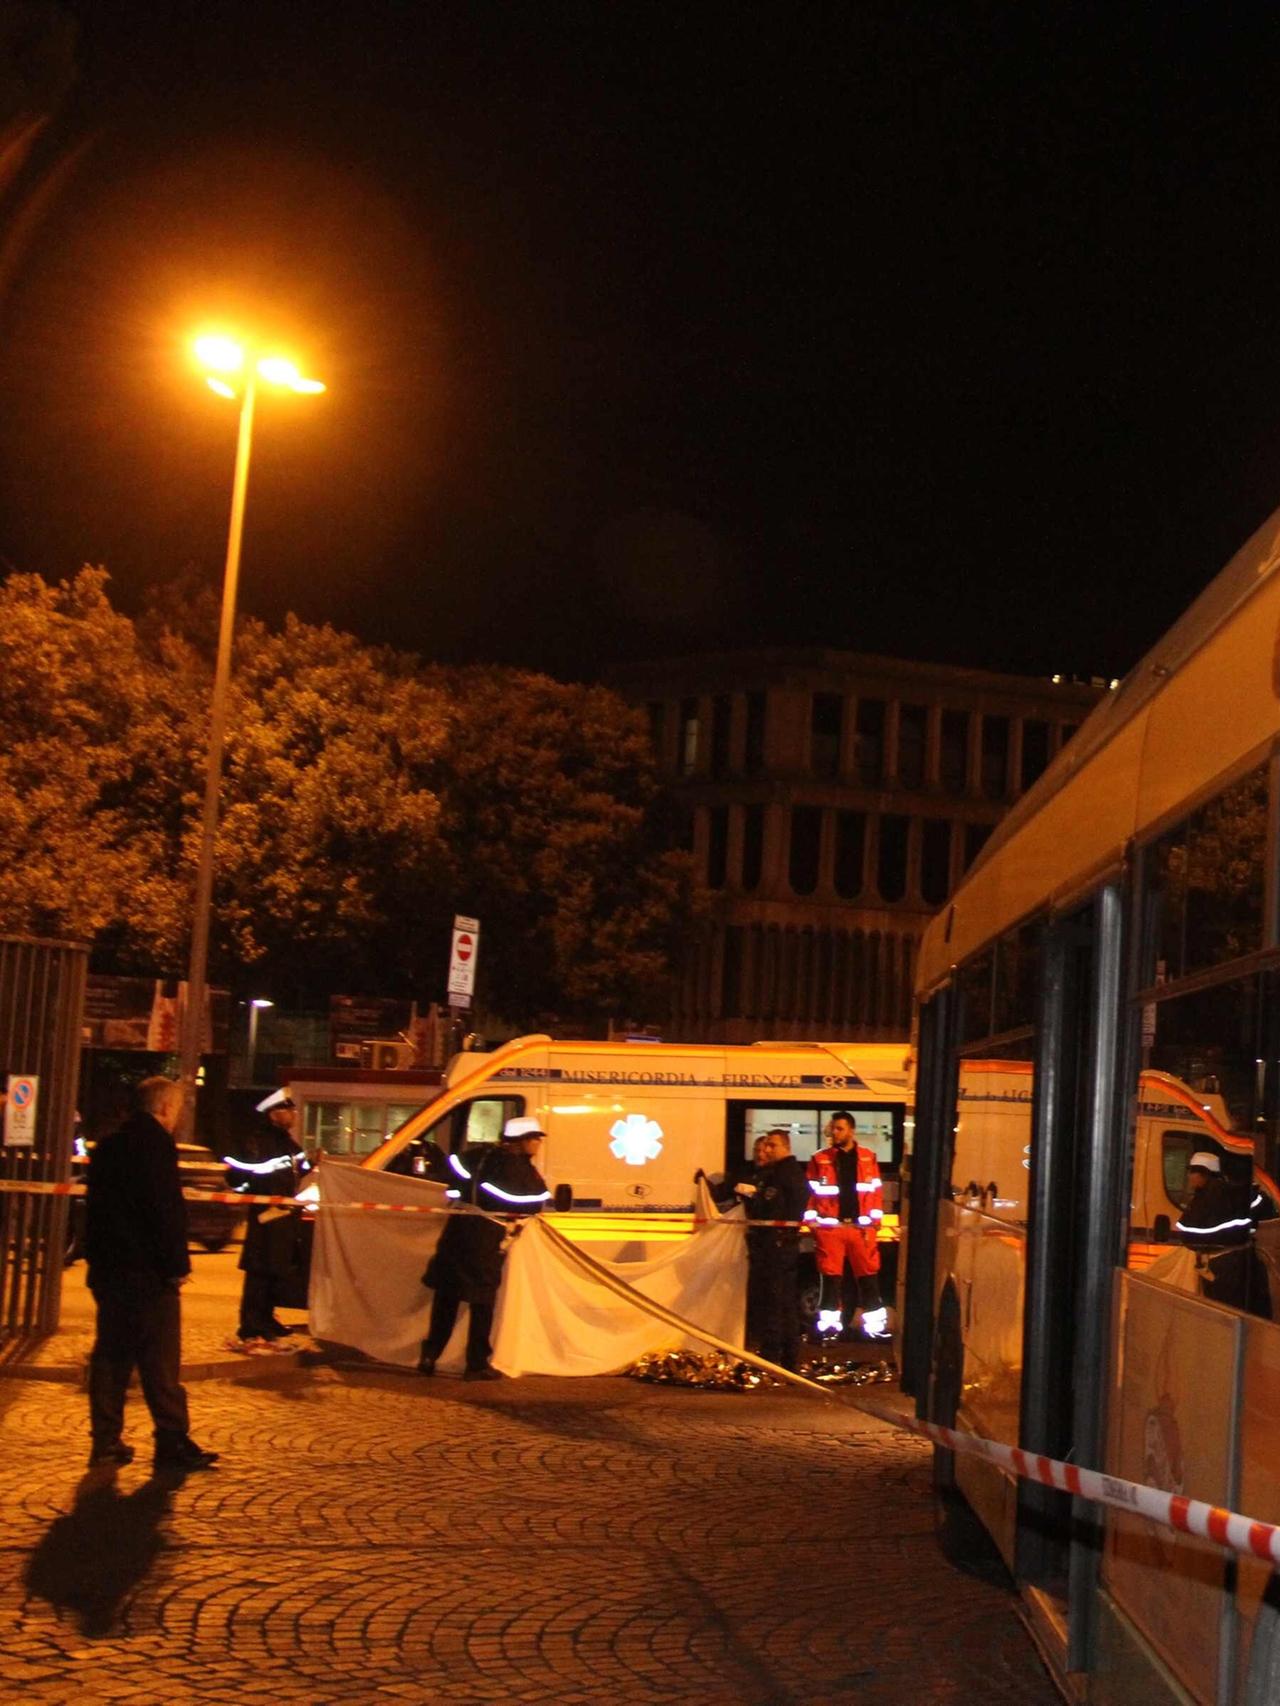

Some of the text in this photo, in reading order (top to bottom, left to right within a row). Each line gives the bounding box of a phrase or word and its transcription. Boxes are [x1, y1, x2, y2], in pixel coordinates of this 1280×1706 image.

[560, 1070, 697, 1085] MISERICORDIA
[721, 1074, 801, 1088] FIRENZE
[822, 1075, 847, 1089] 93
